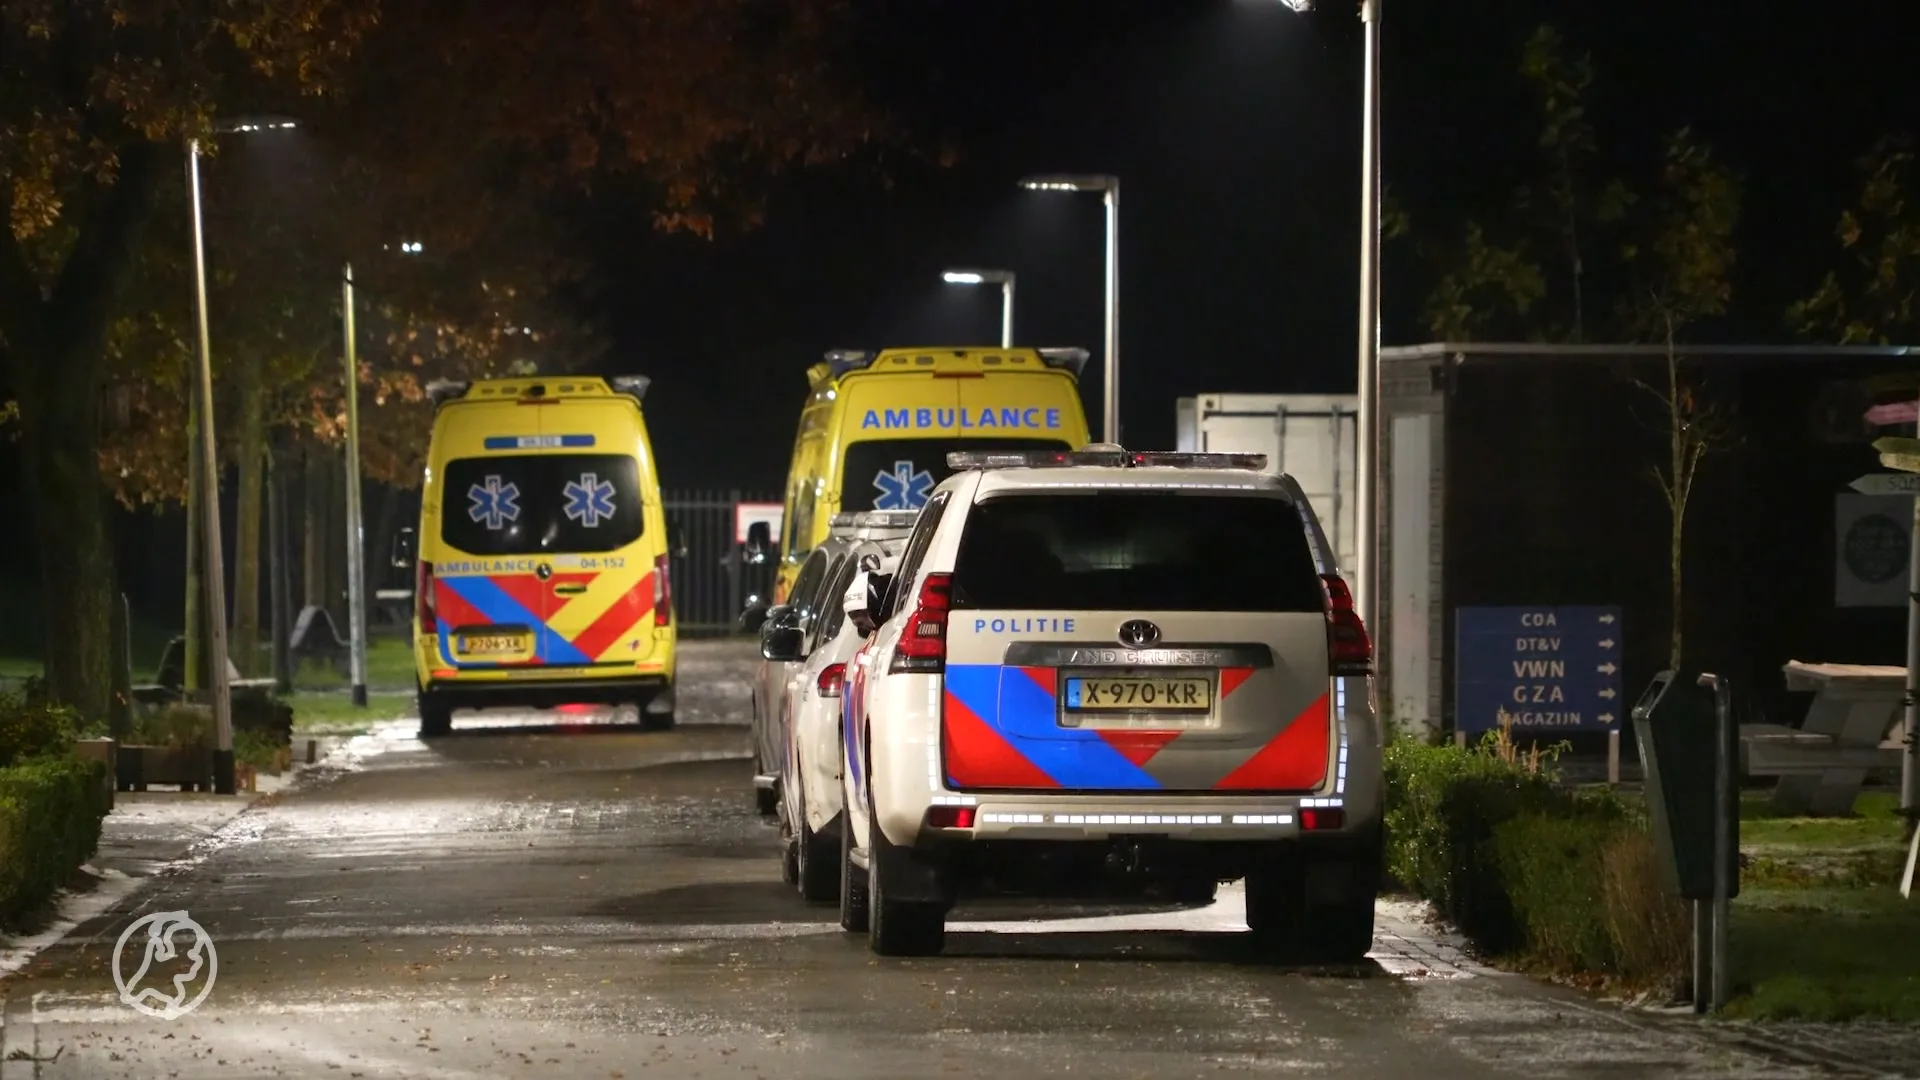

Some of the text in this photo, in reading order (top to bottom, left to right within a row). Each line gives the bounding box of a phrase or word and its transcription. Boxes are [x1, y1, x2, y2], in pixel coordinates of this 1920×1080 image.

[862, 408, 1061, 428] AMBULANCE
[434, 559, 536, 573] AMBULANCE
[580, 557, 625, 569] 04-152
[975, 618, 1075, 633] POLITIE
[1521, 613, 1557, 627] COA
[1516, 638, 1561, 651] DT&V
[1513, 660, 1565, 678] VWN
[1086, 683, 1198, 704] X-970-KR
